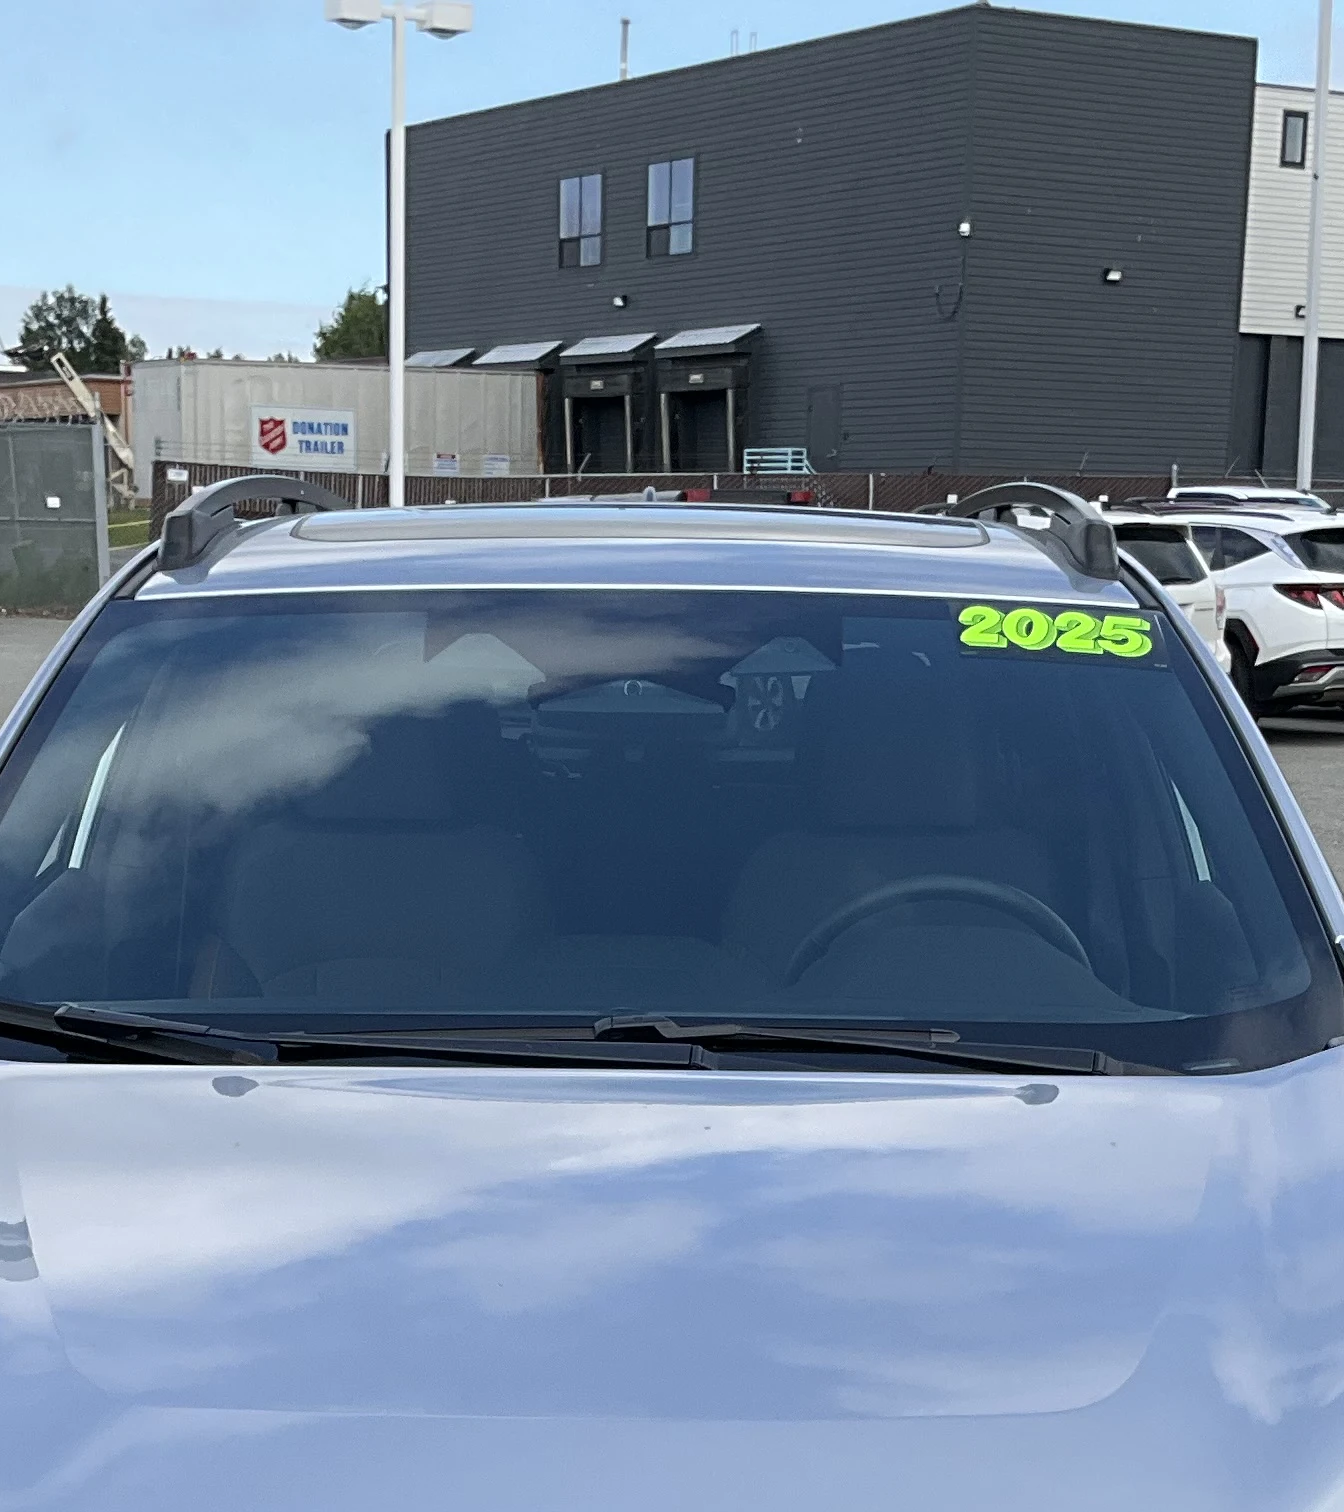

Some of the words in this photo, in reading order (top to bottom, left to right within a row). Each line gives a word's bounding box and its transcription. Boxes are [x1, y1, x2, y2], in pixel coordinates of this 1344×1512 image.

[292, 421, 349, 436] DONATION
[297, 439, 345, 455] TRAILER
[958, 605, 1153, 658] 2025
